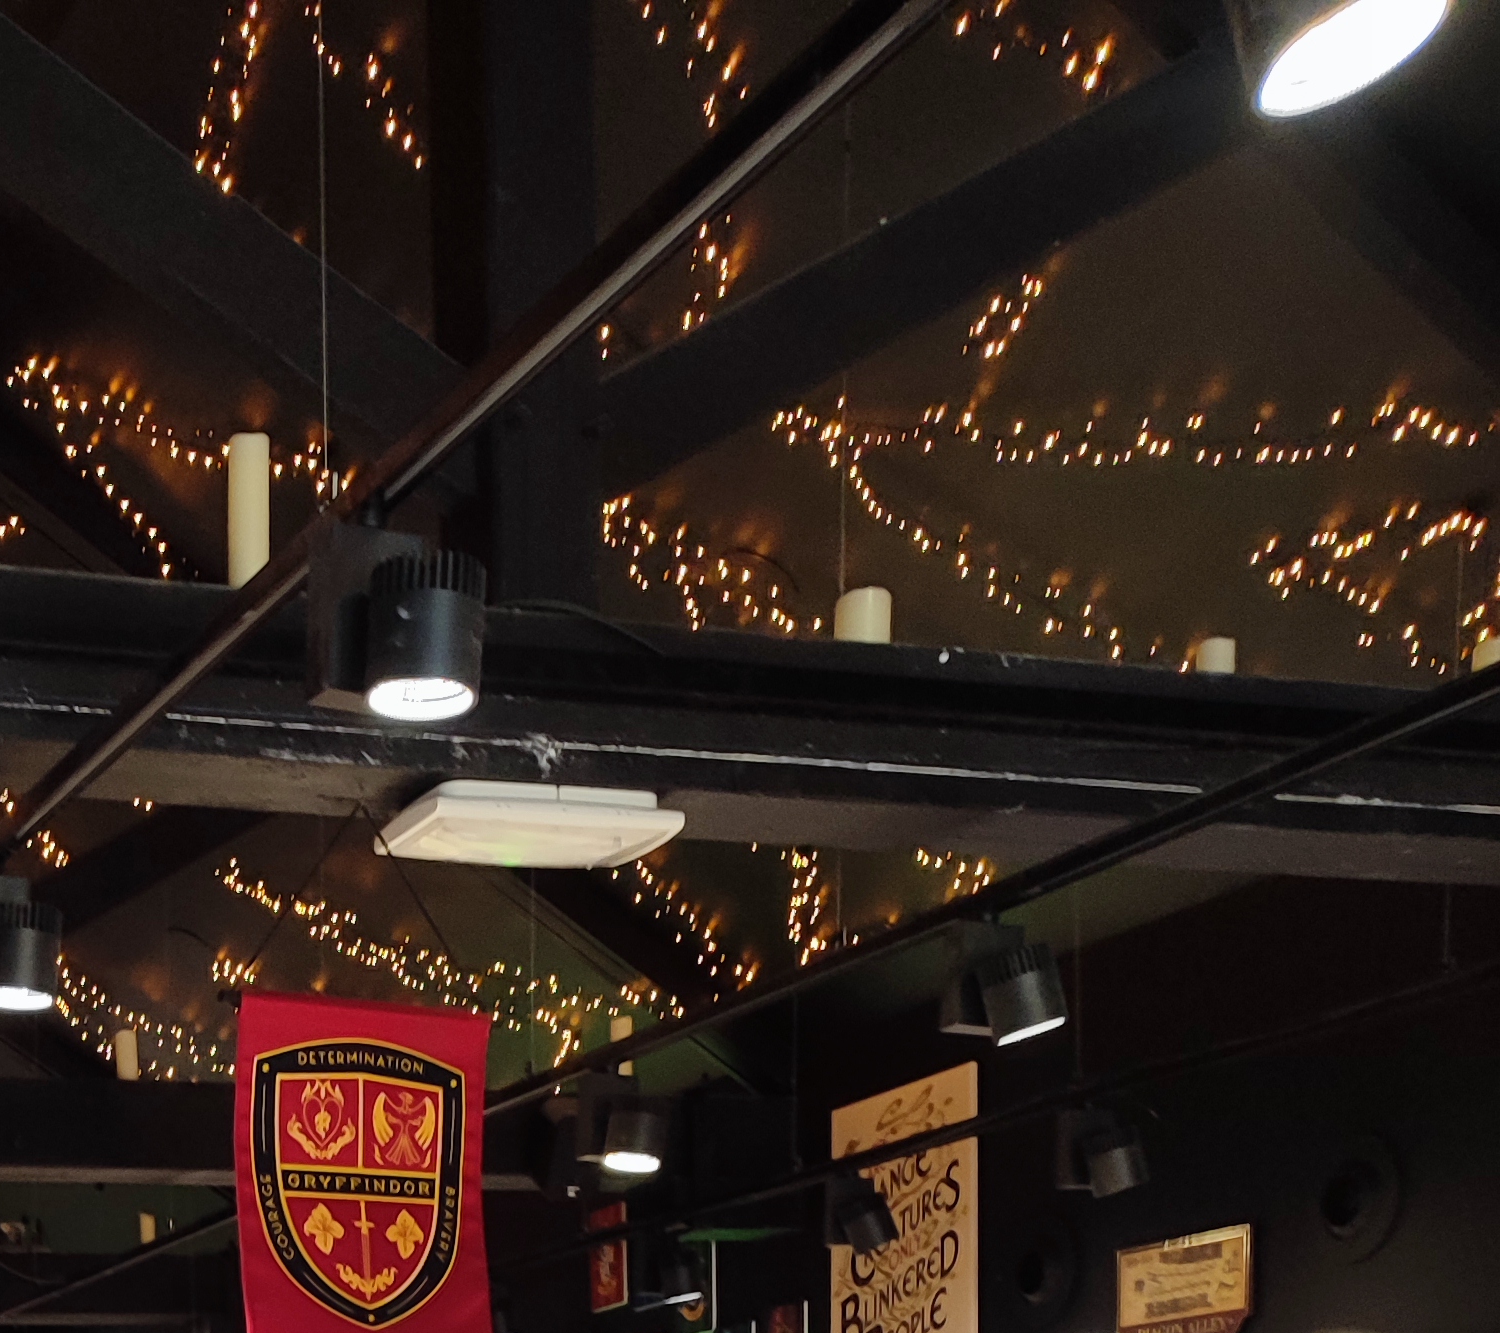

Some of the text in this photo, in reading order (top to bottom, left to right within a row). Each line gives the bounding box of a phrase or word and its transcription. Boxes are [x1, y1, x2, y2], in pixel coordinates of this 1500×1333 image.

[297, 1050, 425, 1076] DETERMINATION
[287, 1172, 432, 1198] GRYFFINDOR
[259, 1173, 295, 1261] COURAGE
[437, 1185, 456, 1264] BRAVERY
